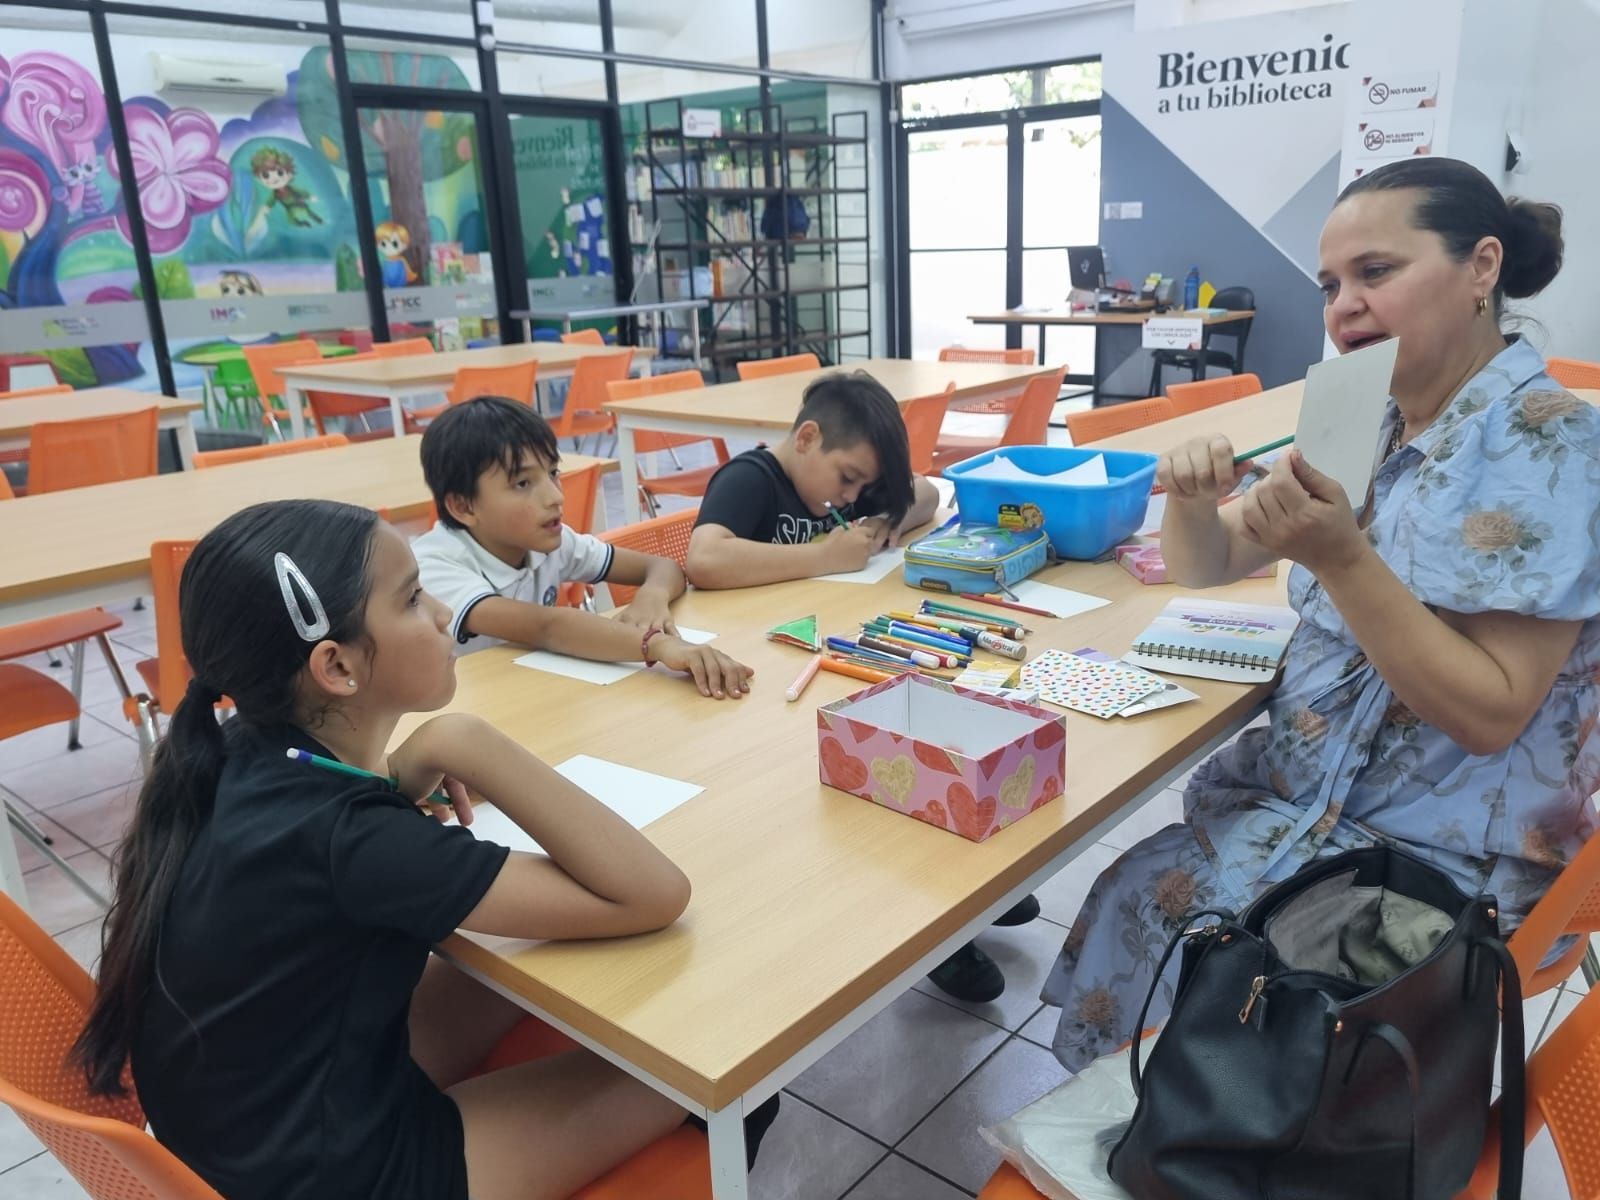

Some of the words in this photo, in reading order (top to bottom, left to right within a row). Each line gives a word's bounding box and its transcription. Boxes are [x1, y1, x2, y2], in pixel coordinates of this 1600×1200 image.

[1157, 97, 1171, 115] a
[1177, 91, 1201, 113] tu
[1207, 79, 1333, 110] biblioteca
[1390, 88, 1401, 96] NO
[1402, 86, 1427, 95] FUMAR
